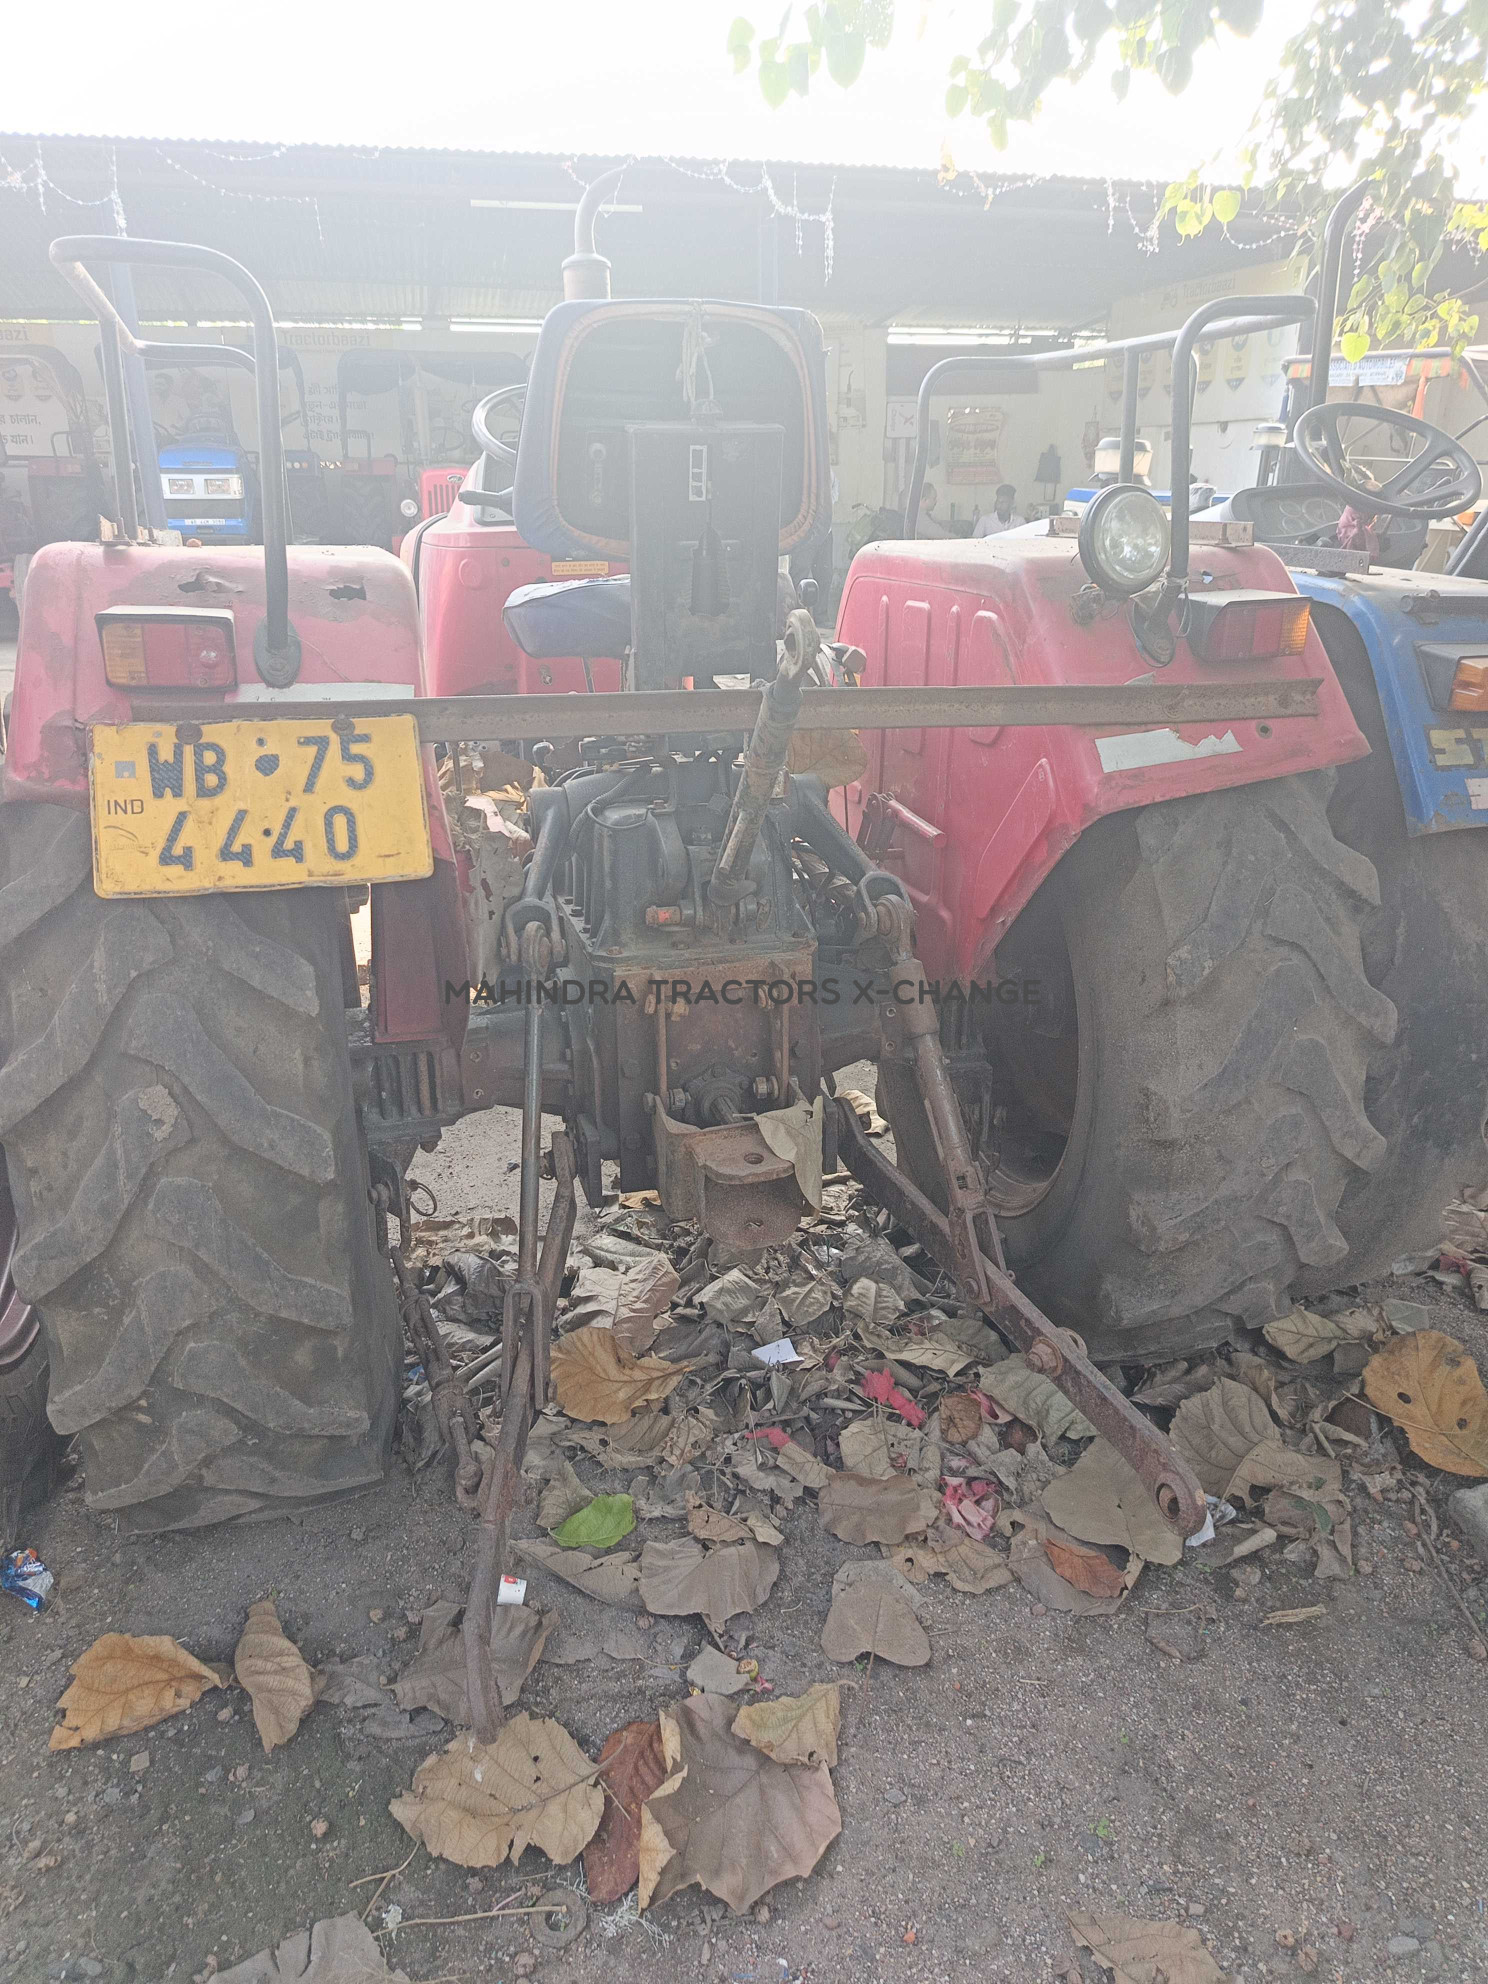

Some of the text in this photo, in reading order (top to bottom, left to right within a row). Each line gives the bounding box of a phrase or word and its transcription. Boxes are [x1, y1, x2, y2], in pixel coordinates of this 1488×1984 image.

[9, 413, 42, 426] চালান,
[147, 733, 375, 799] WB 75
[107, 799, 144, 815] IND
[159, 805, 359, 872] 4440
